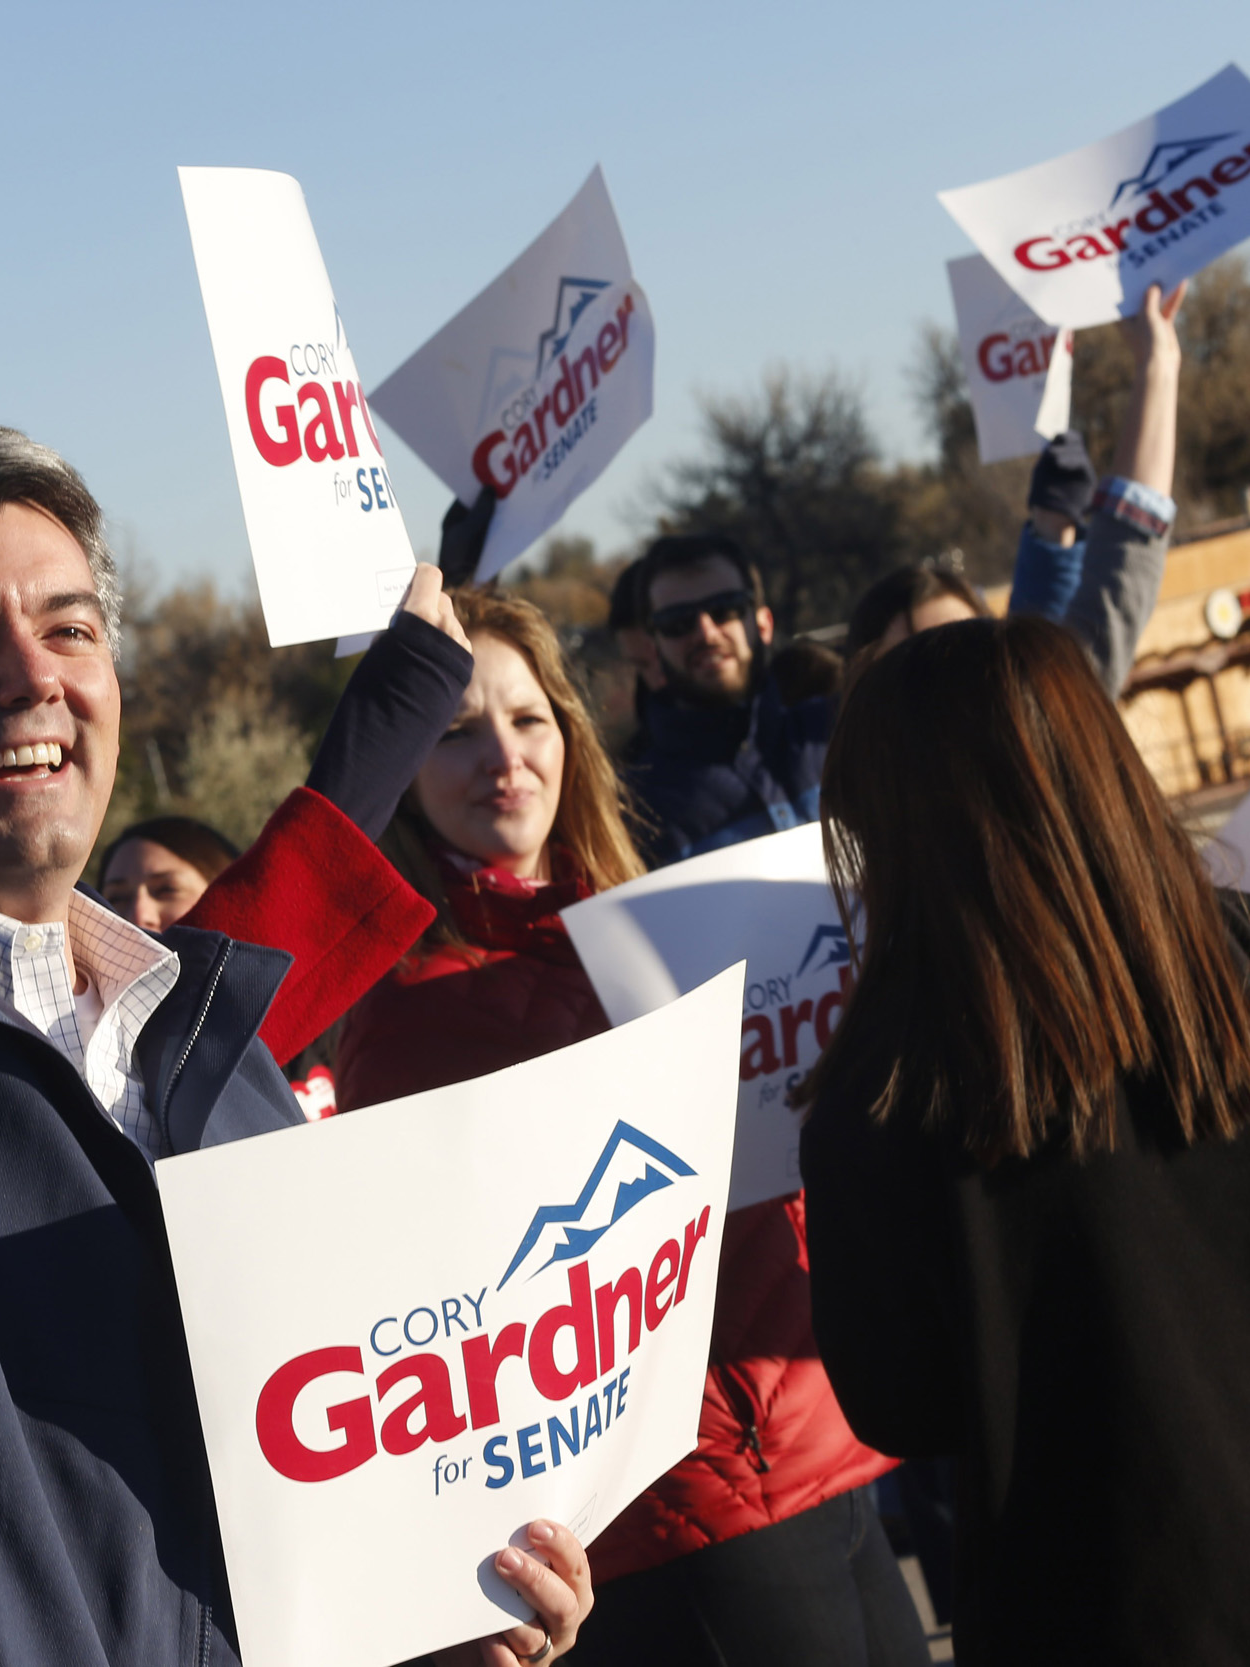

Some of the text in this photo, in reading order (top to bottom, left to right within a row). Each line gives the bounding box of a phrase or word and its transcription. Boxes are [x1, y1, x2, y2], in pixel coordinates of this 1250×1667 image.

[1126, 201, 1226, 269] SENATE
[289, 343, 339, 376] CORY
[471, 292, 634, 499] Gardner
[501, 386, 539, 431] CORY
[543, 397, 597, 480] SENATE
[334, 472, 352, 506] for
[743, 973, 792, 1014] ORY
[256, 1205, 711, 1482] Gardner
[370, 1286, 488, 1356] CORY
[432, 1365, 631, 1496] for SENATE
